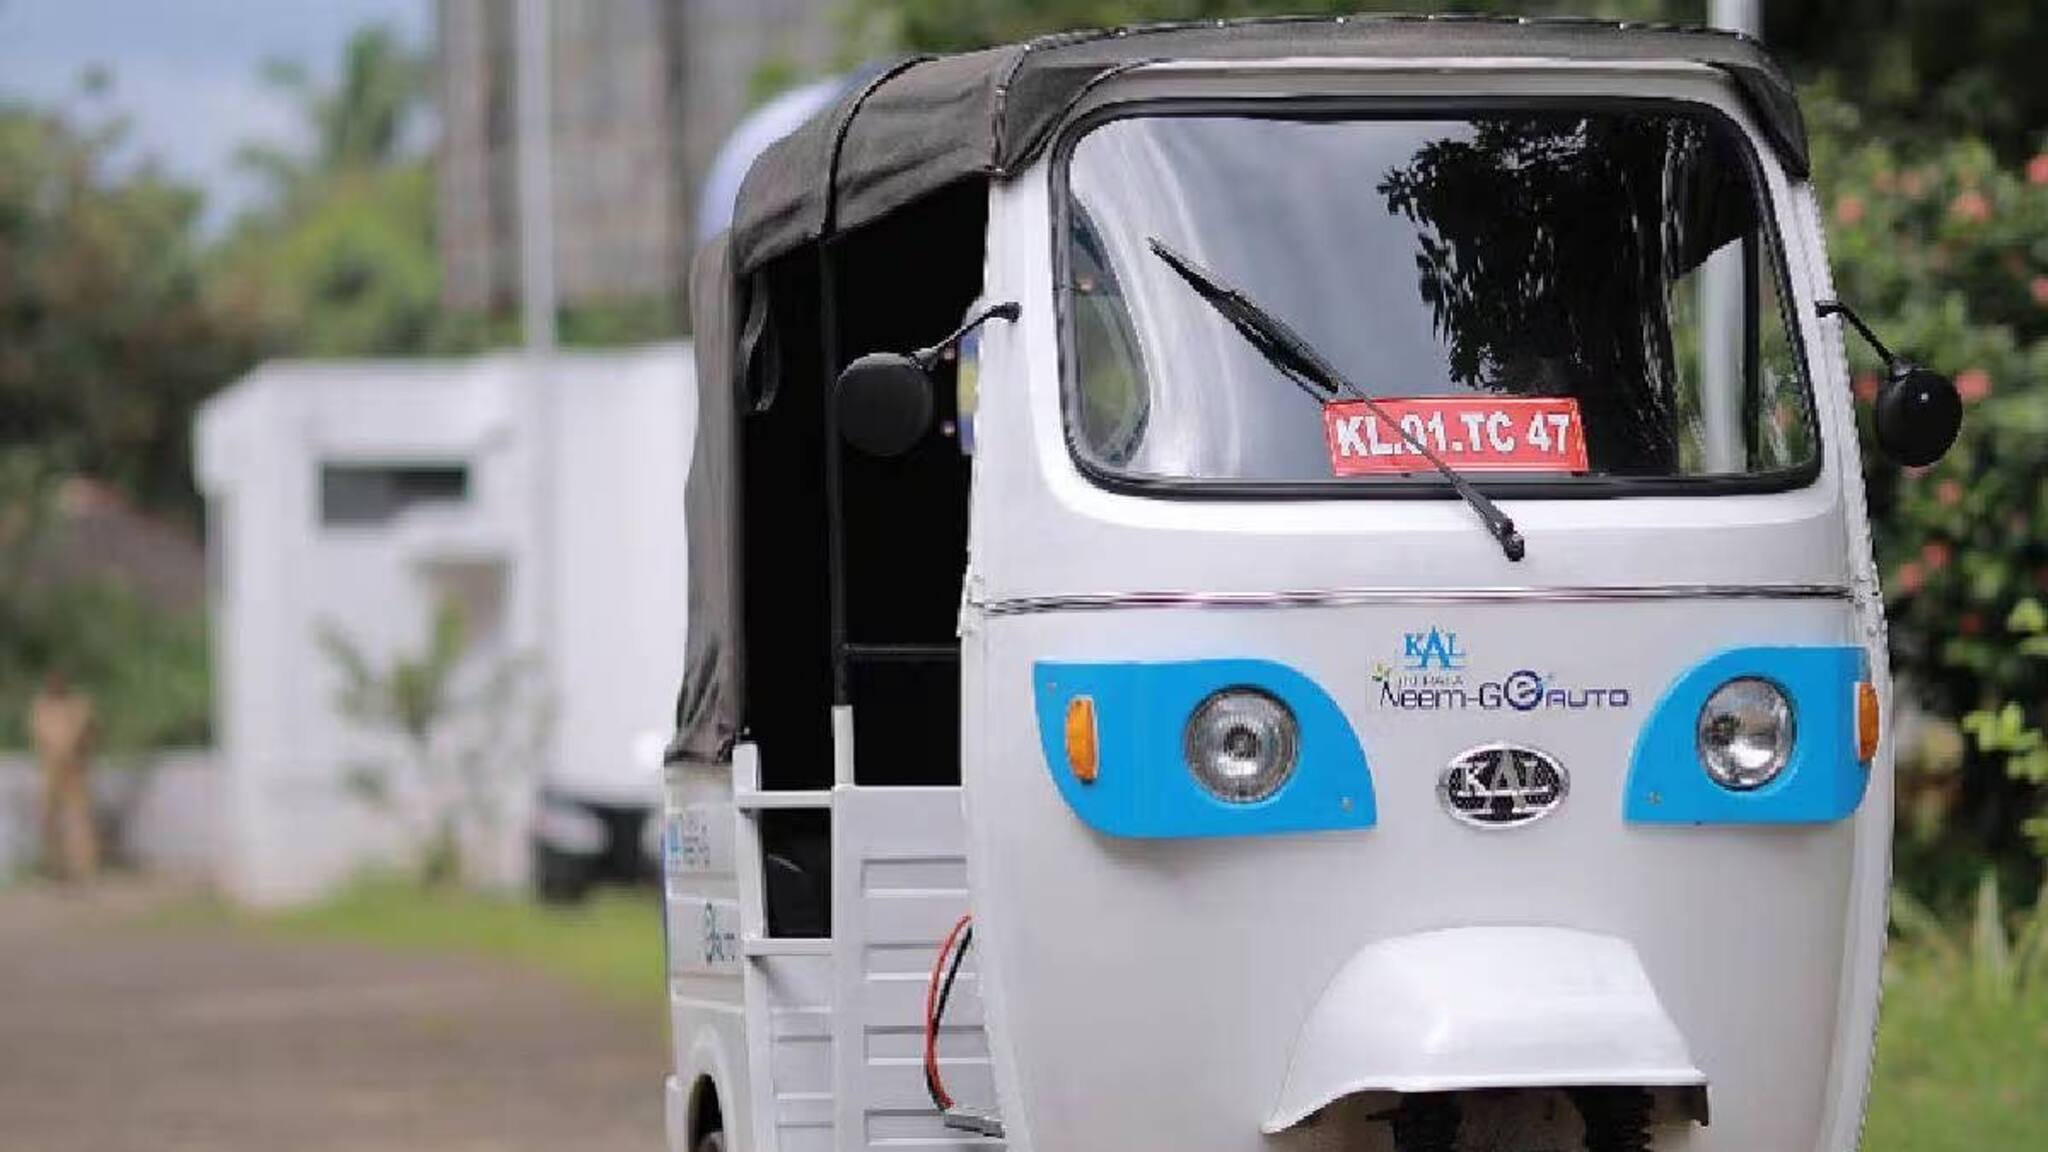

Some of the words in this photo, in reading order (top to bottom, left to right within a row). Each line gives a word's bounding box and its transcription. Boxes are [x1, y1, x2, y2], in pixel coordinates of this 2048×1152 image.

[1527, 411, 1570, 453] 47
[1404, 625, 1466, 668] KAL
[1455, 749, 1551, 815] KAL
